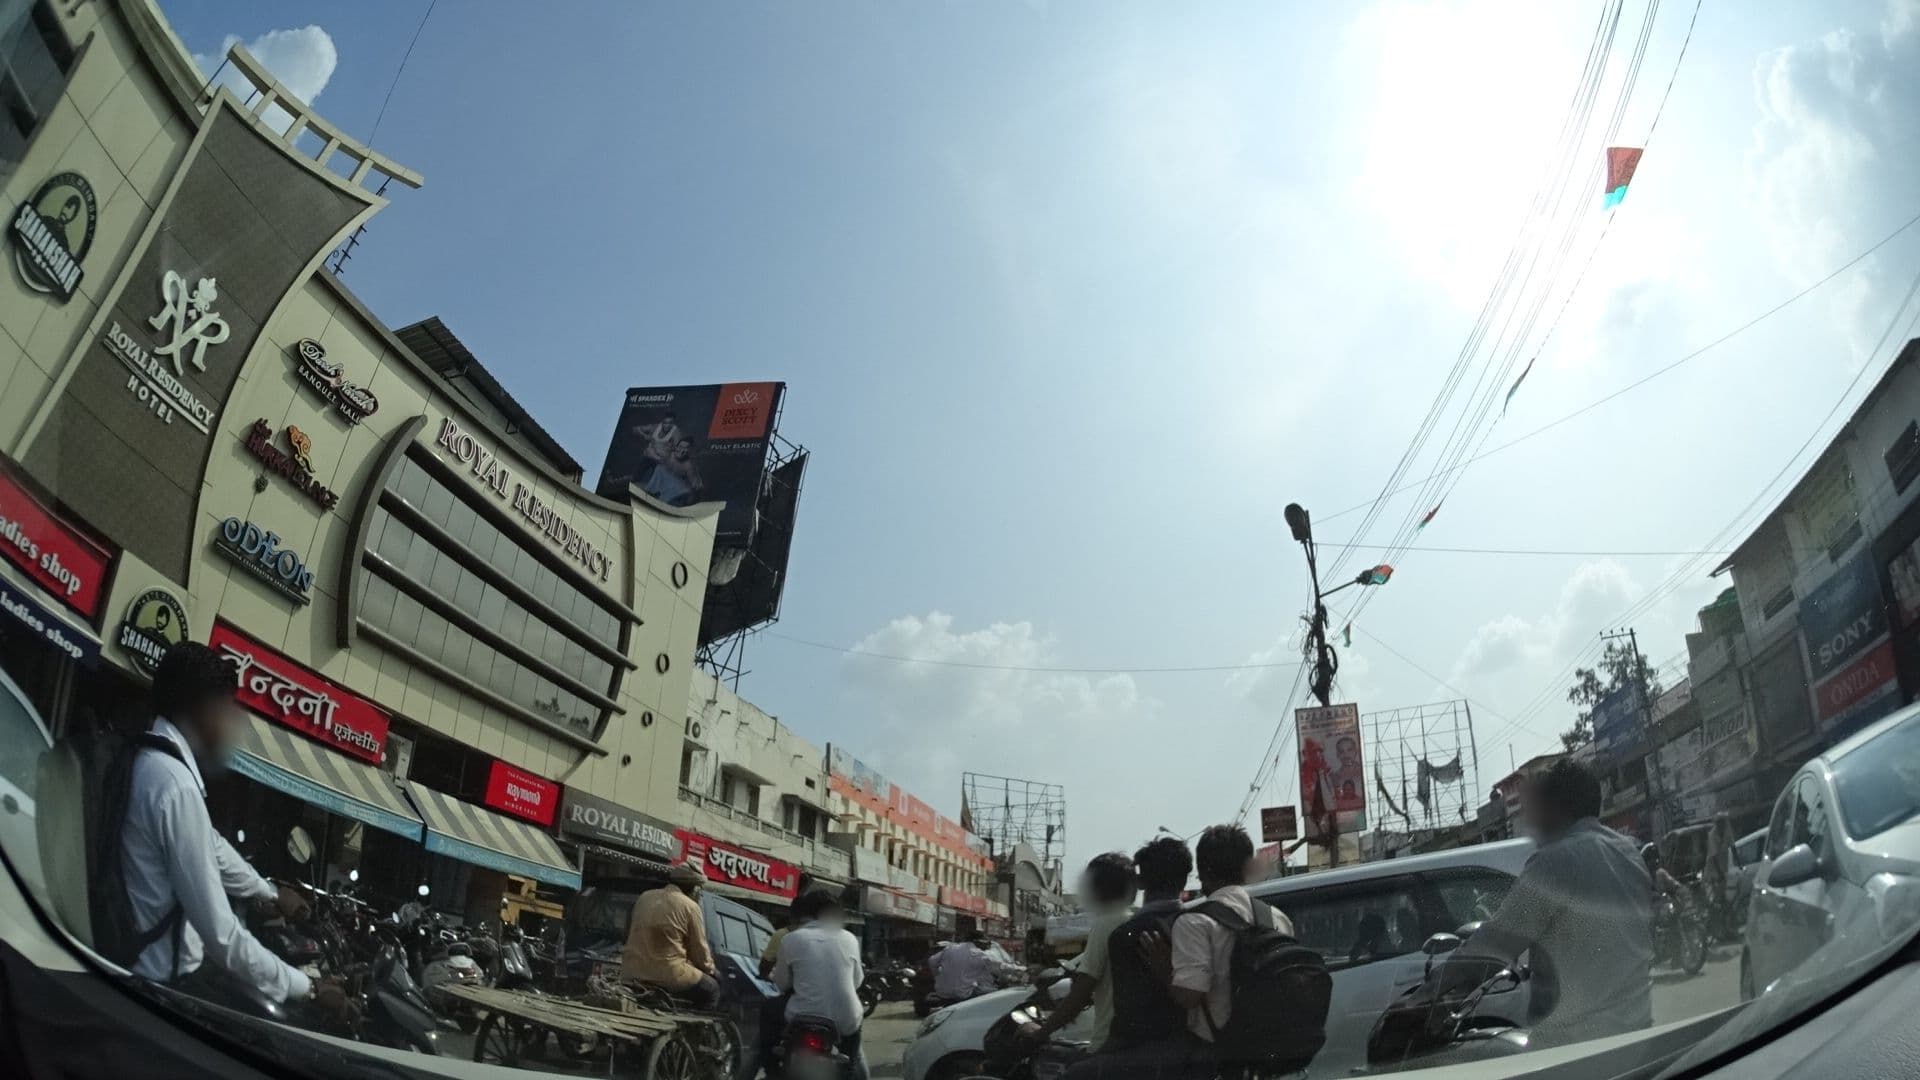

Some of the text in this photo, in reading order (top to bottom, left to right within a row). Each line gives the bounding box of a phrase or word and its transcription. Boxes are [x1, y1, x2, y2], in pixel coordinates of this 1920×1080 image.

[108, 321, 215, 426] ROYAL RESIDENCY
[299, 364, 361, 424] BANQUET HALL
[127, 375, 174, 424] HOTEL
[439, 416, 615, 582] ROYAL RESIDENCY
[40, 551, 82, 596] shop
[223, 516, 315, 592] ODEON
[1820, 610, 1873, 665] SONY
[1830, 661, 1881, 706] ONIDA
[506, 783, 541, 806] Raymond
[571, 804, 628, 836] ROYAL
[708, 846, 771, 884] अनुराधा
